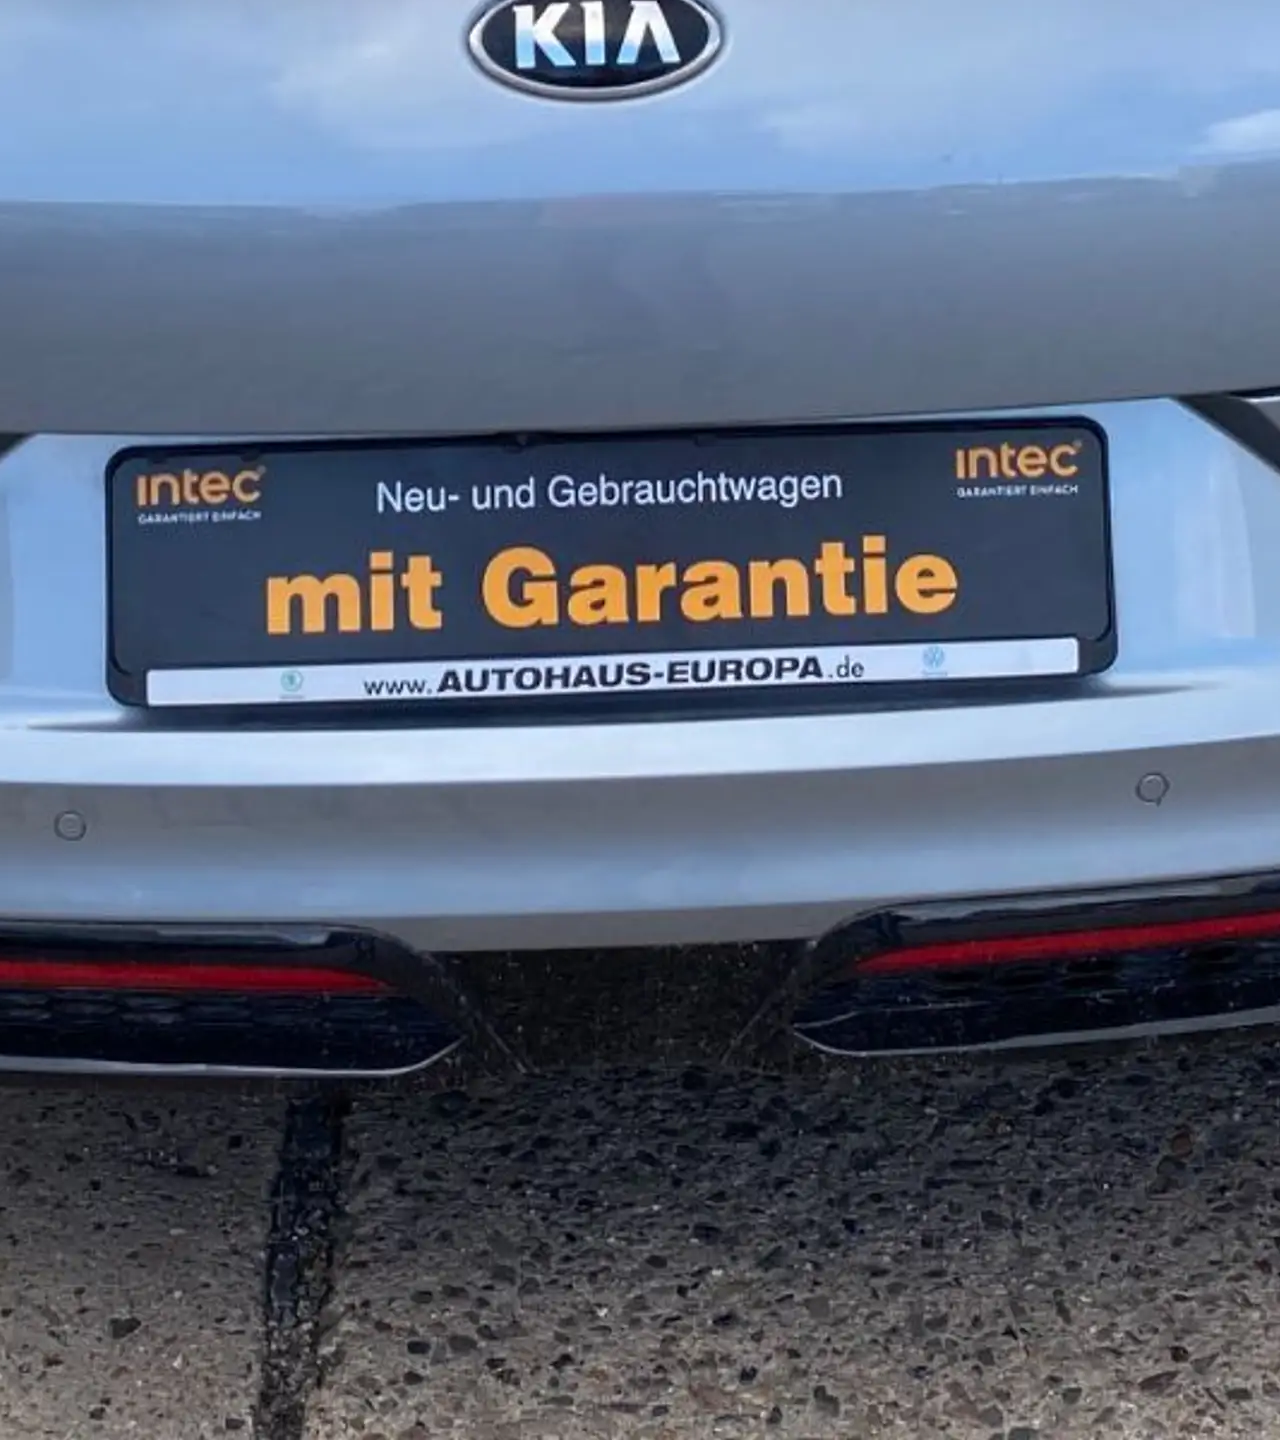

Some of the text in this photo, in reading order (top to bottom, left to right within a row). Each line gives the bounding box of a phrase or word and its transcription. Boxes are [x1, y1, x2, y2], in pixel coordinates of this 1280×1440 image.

[512, 0, 681, 68] KIA
[956, 442, 1079, 479] intec
[136, 467, 262, 506] intec
[376, 471, 843, 513] Neu- und Gebrauchtwagen
[266, 534, 959, 635] mit Garantie
[363, 654, 865, 696] www.AUTOHAUS-EUROPA.de
